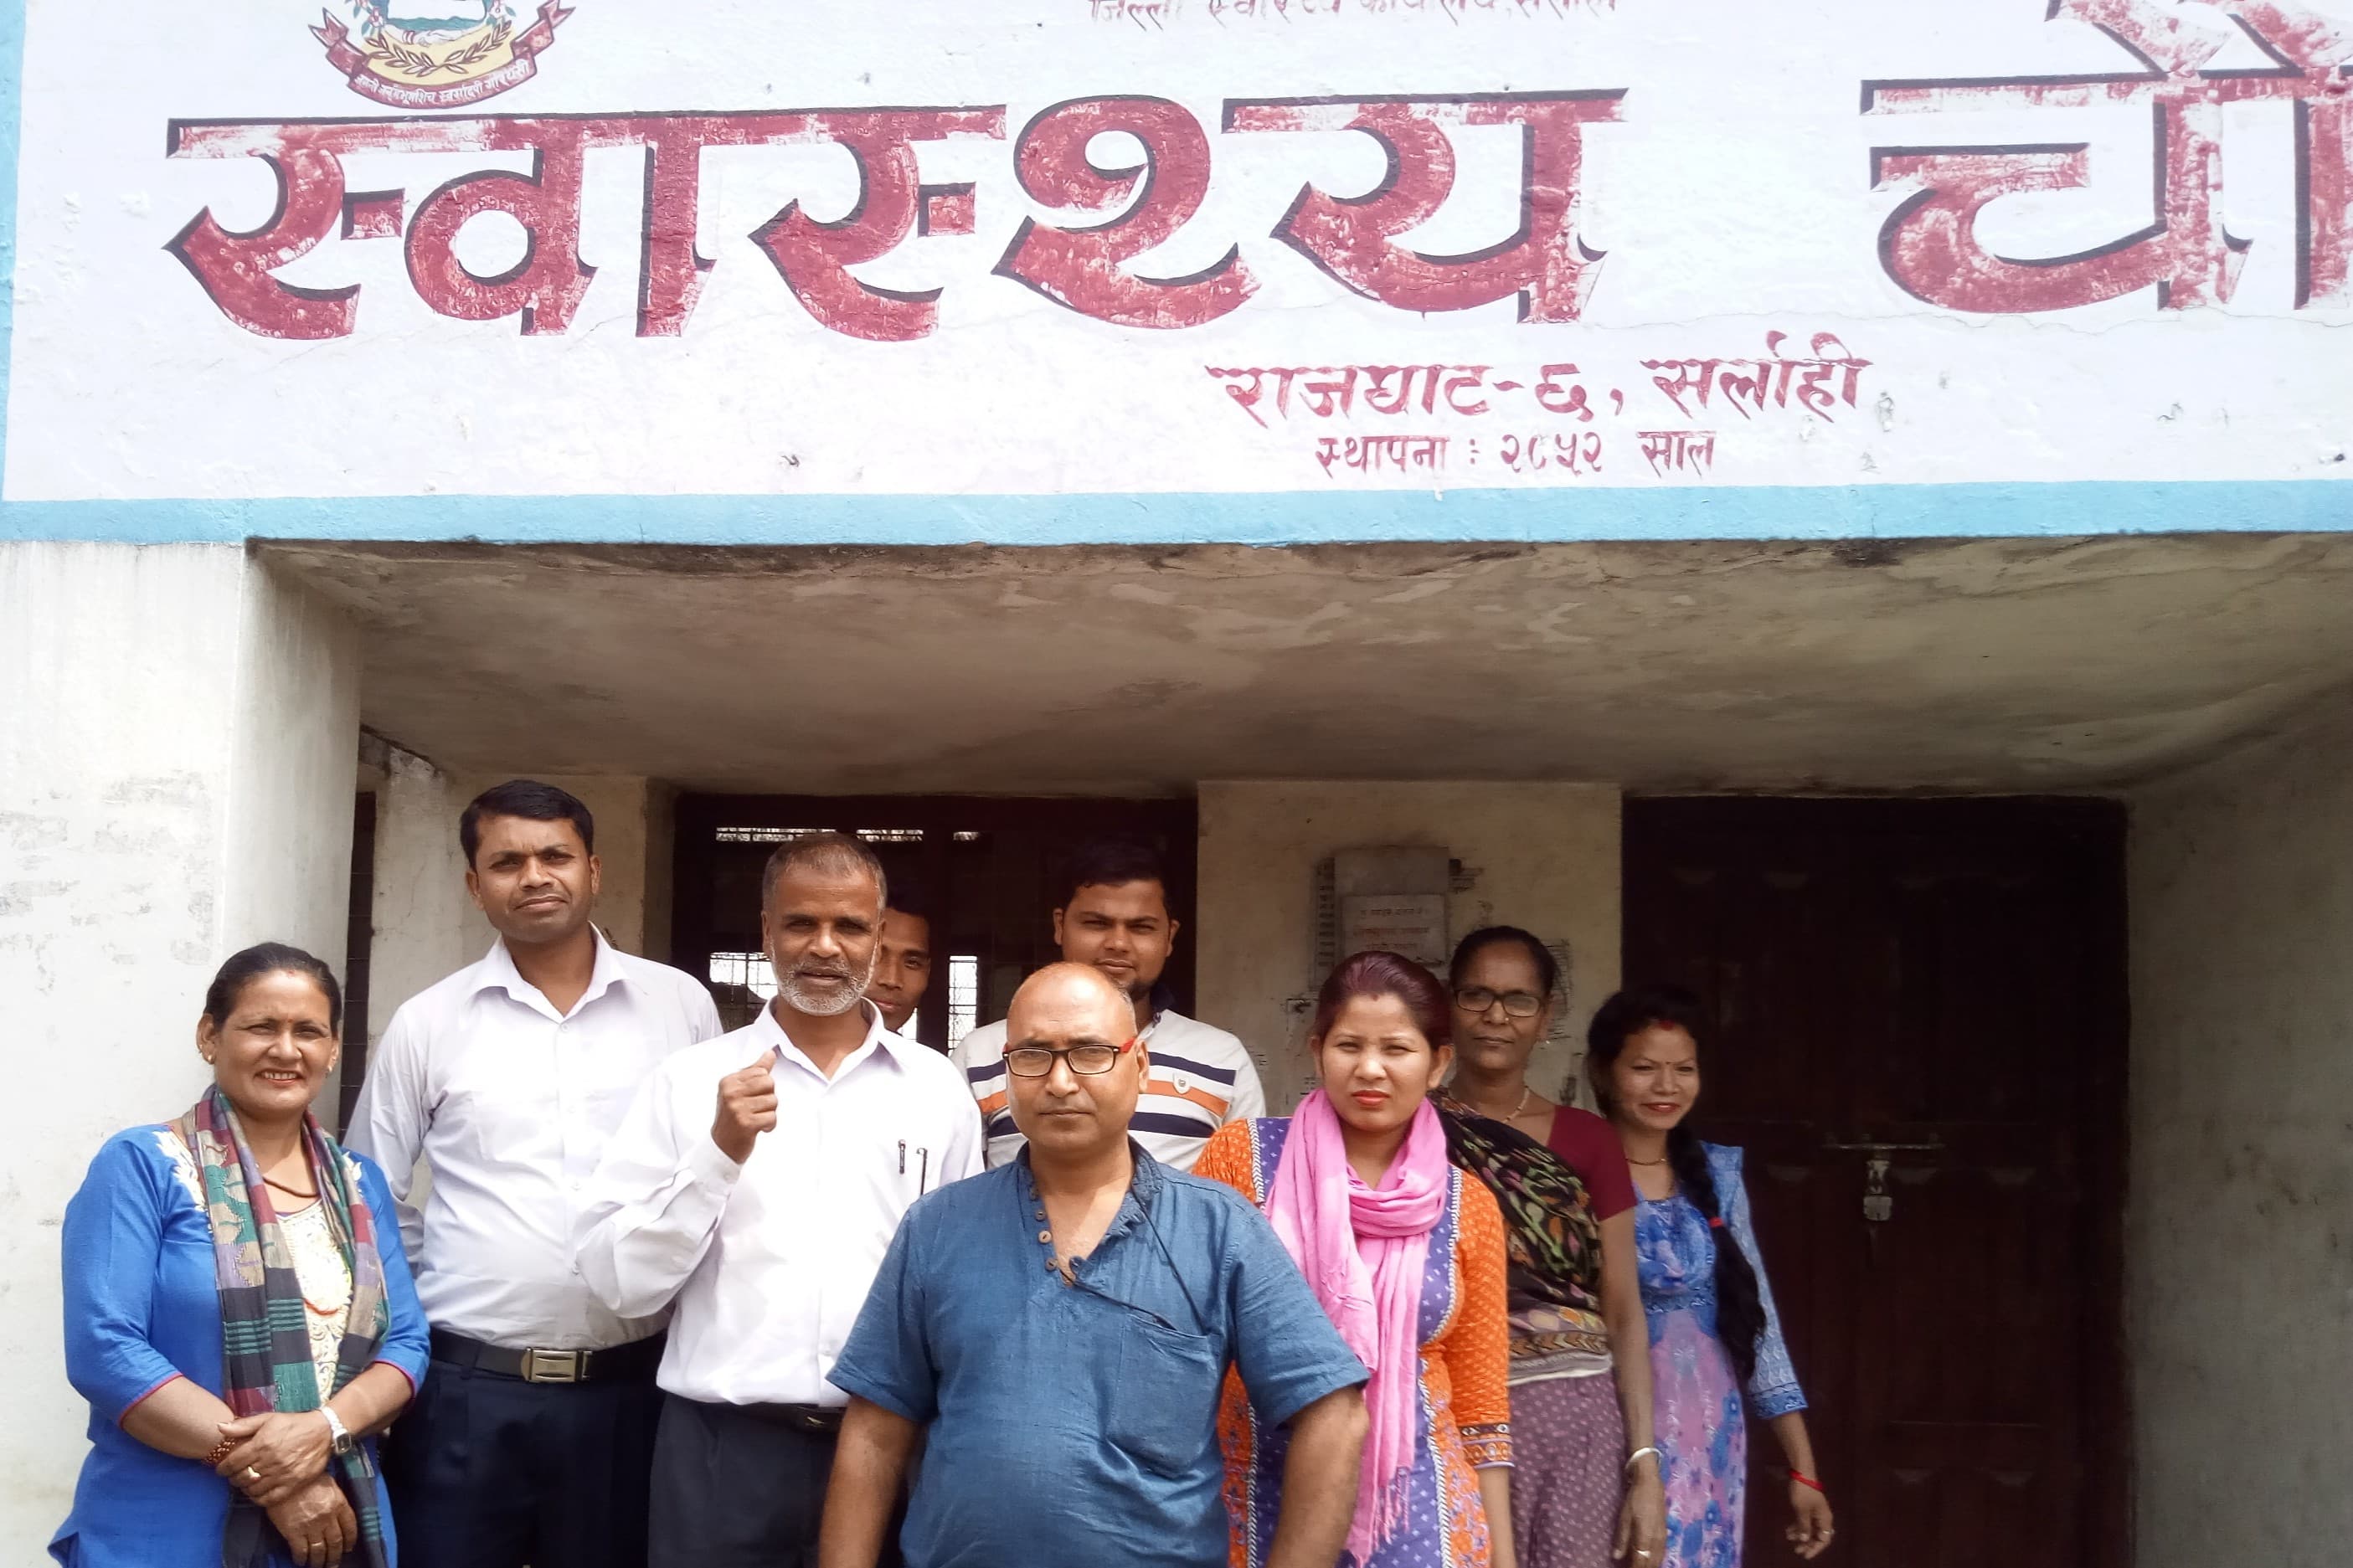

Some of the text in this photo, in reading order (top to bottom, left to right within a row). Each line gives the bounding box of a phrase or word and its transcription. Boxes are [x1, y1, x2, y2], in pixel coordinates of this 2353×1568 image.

[162, 87, 1630, 340] स्वास्थ्य
[1640, 330, 1874, 424] सर्लाही
[1636, 430, 1717, 478] साल
